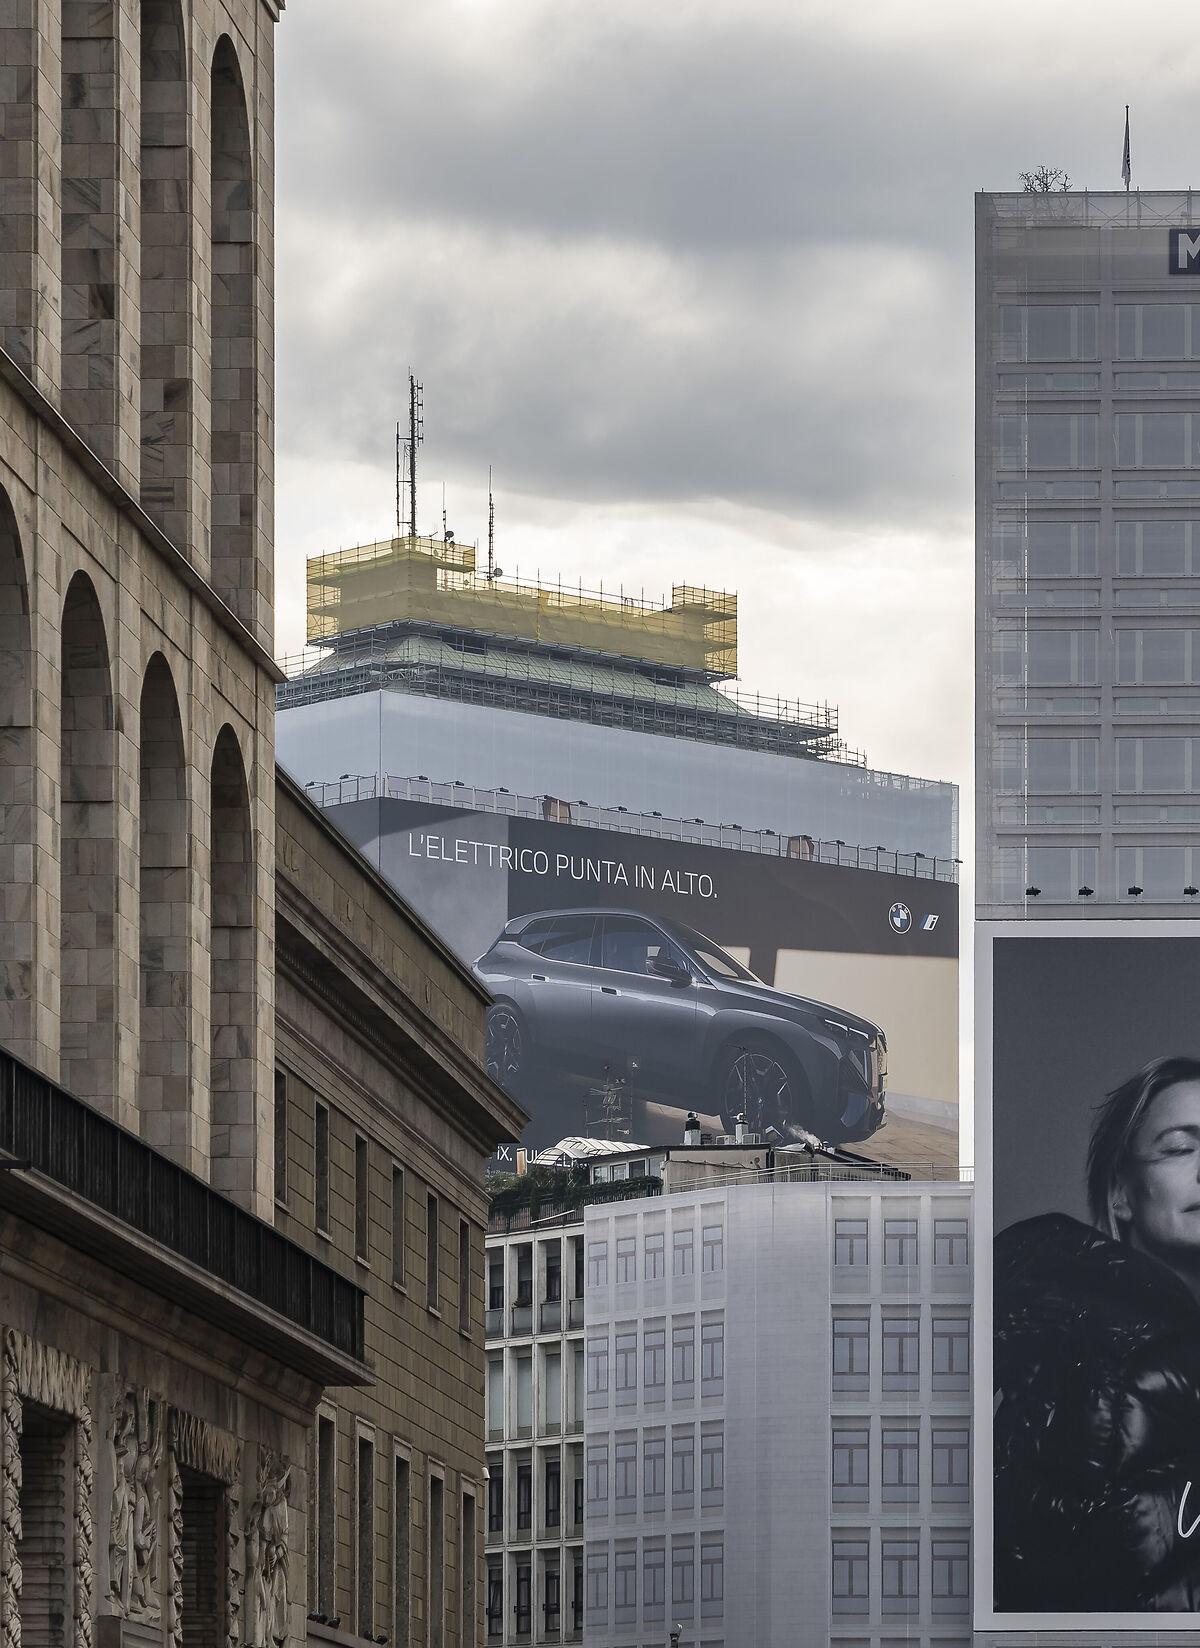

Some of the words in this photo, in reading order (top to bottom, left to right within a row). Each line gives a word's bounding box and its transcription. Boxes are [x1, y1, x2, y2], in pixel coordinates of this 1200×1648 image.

[556, 854, 629, 886] PUNTA
[634, 865, 655, 889] IN
[661, 869, 718, 898] ALTO.
